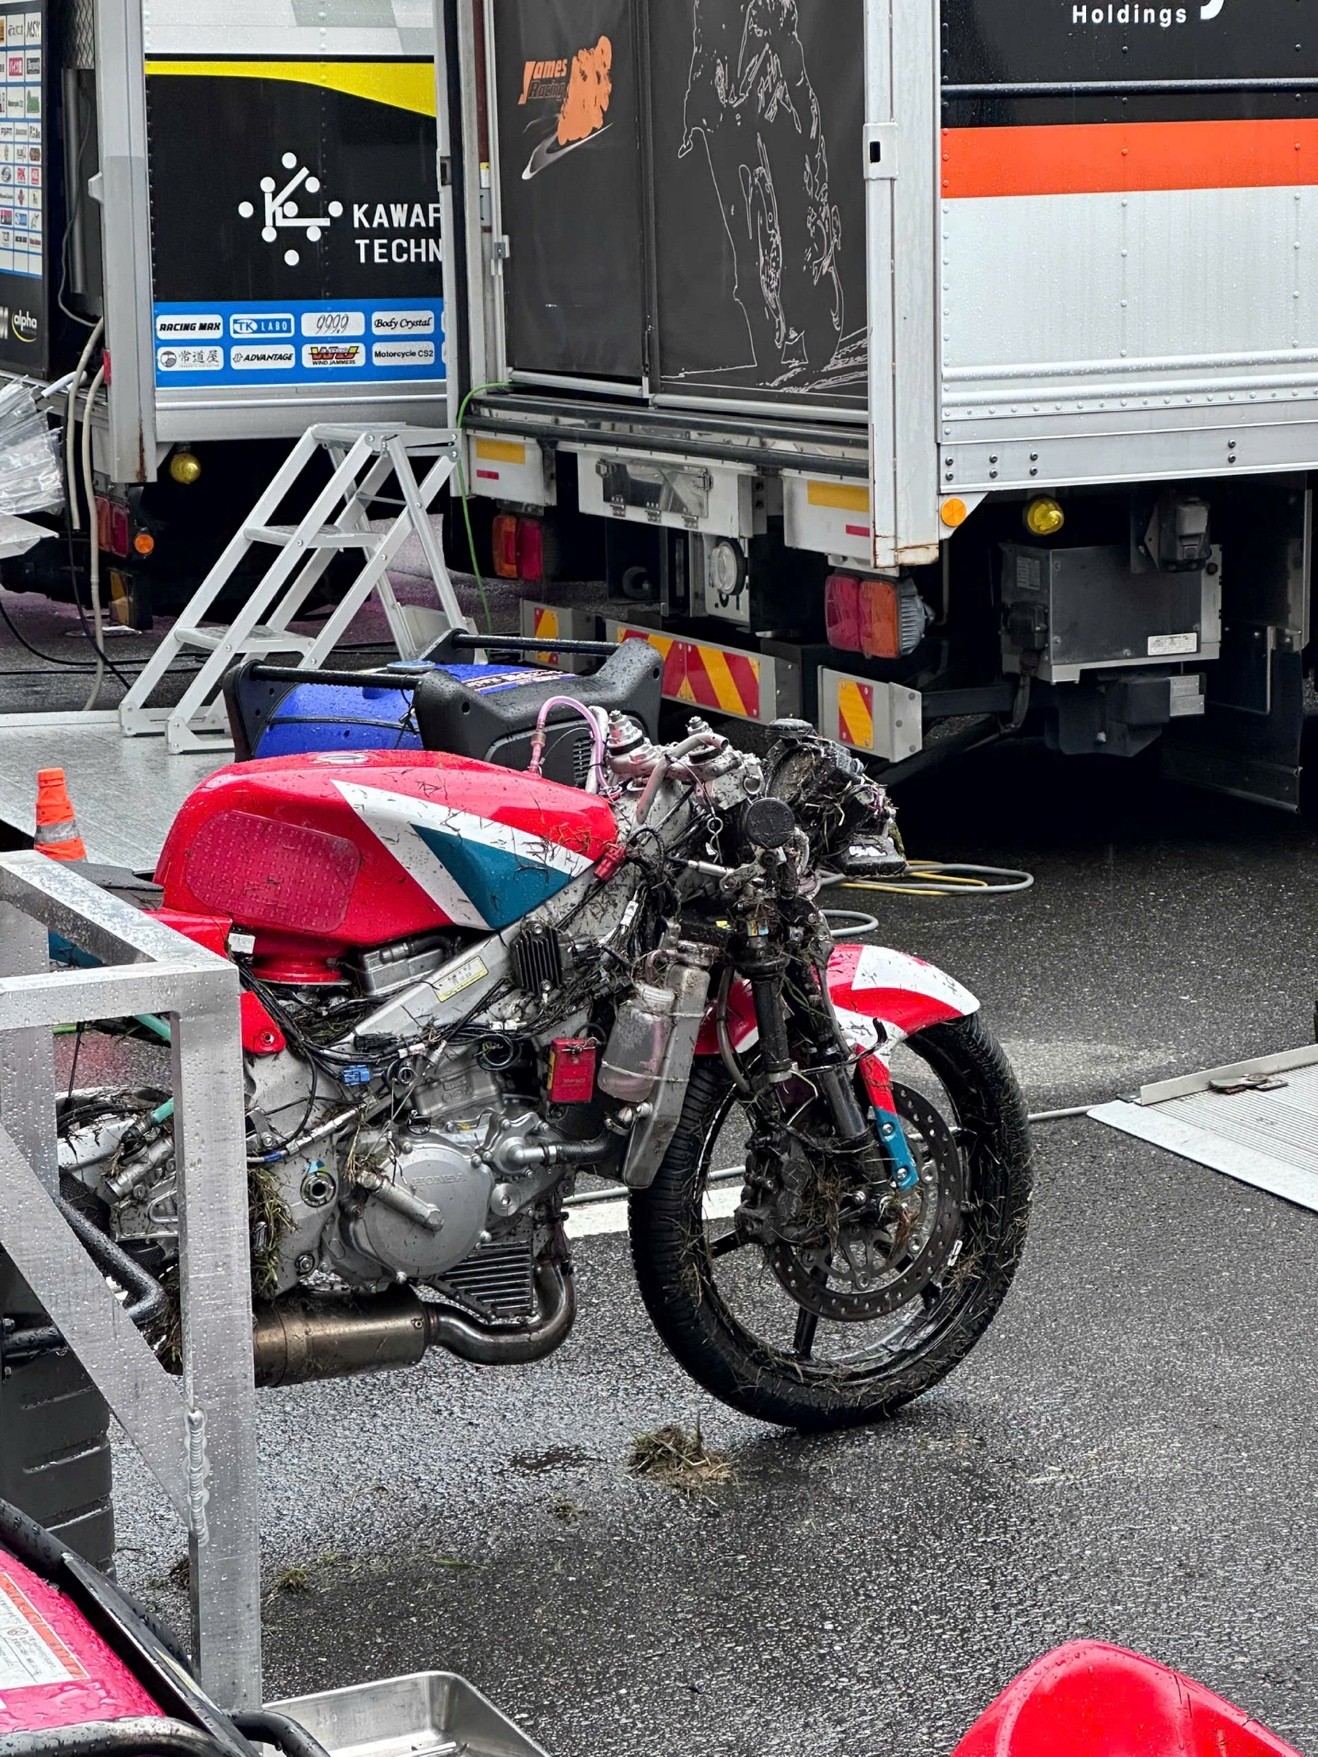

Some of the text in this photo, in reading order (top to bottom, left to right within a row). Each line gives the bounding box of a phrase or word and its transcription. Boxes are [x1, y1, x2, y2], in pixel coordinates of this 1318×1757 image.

[1072, 4, 1187, 28] Holdings
[518, 59, 568, 105] James
[528, 80, 568, 101] Racing
[355, 238, 443, 264] TECHN
[14, 309, 37, 331] alpha
[159, 322, 221, 331] RACING MAX
[239, 321, 287, 332] TK LABO
[374, 316, 432, 330] Body Crystal
[179, 350, 219, 363] 常道屋
[243, 353, 293, 362] ADVANTAGE
[374, 348, 434, 359] Motorcycle CS2
[411, 1172, 467, 1187] HONDA
